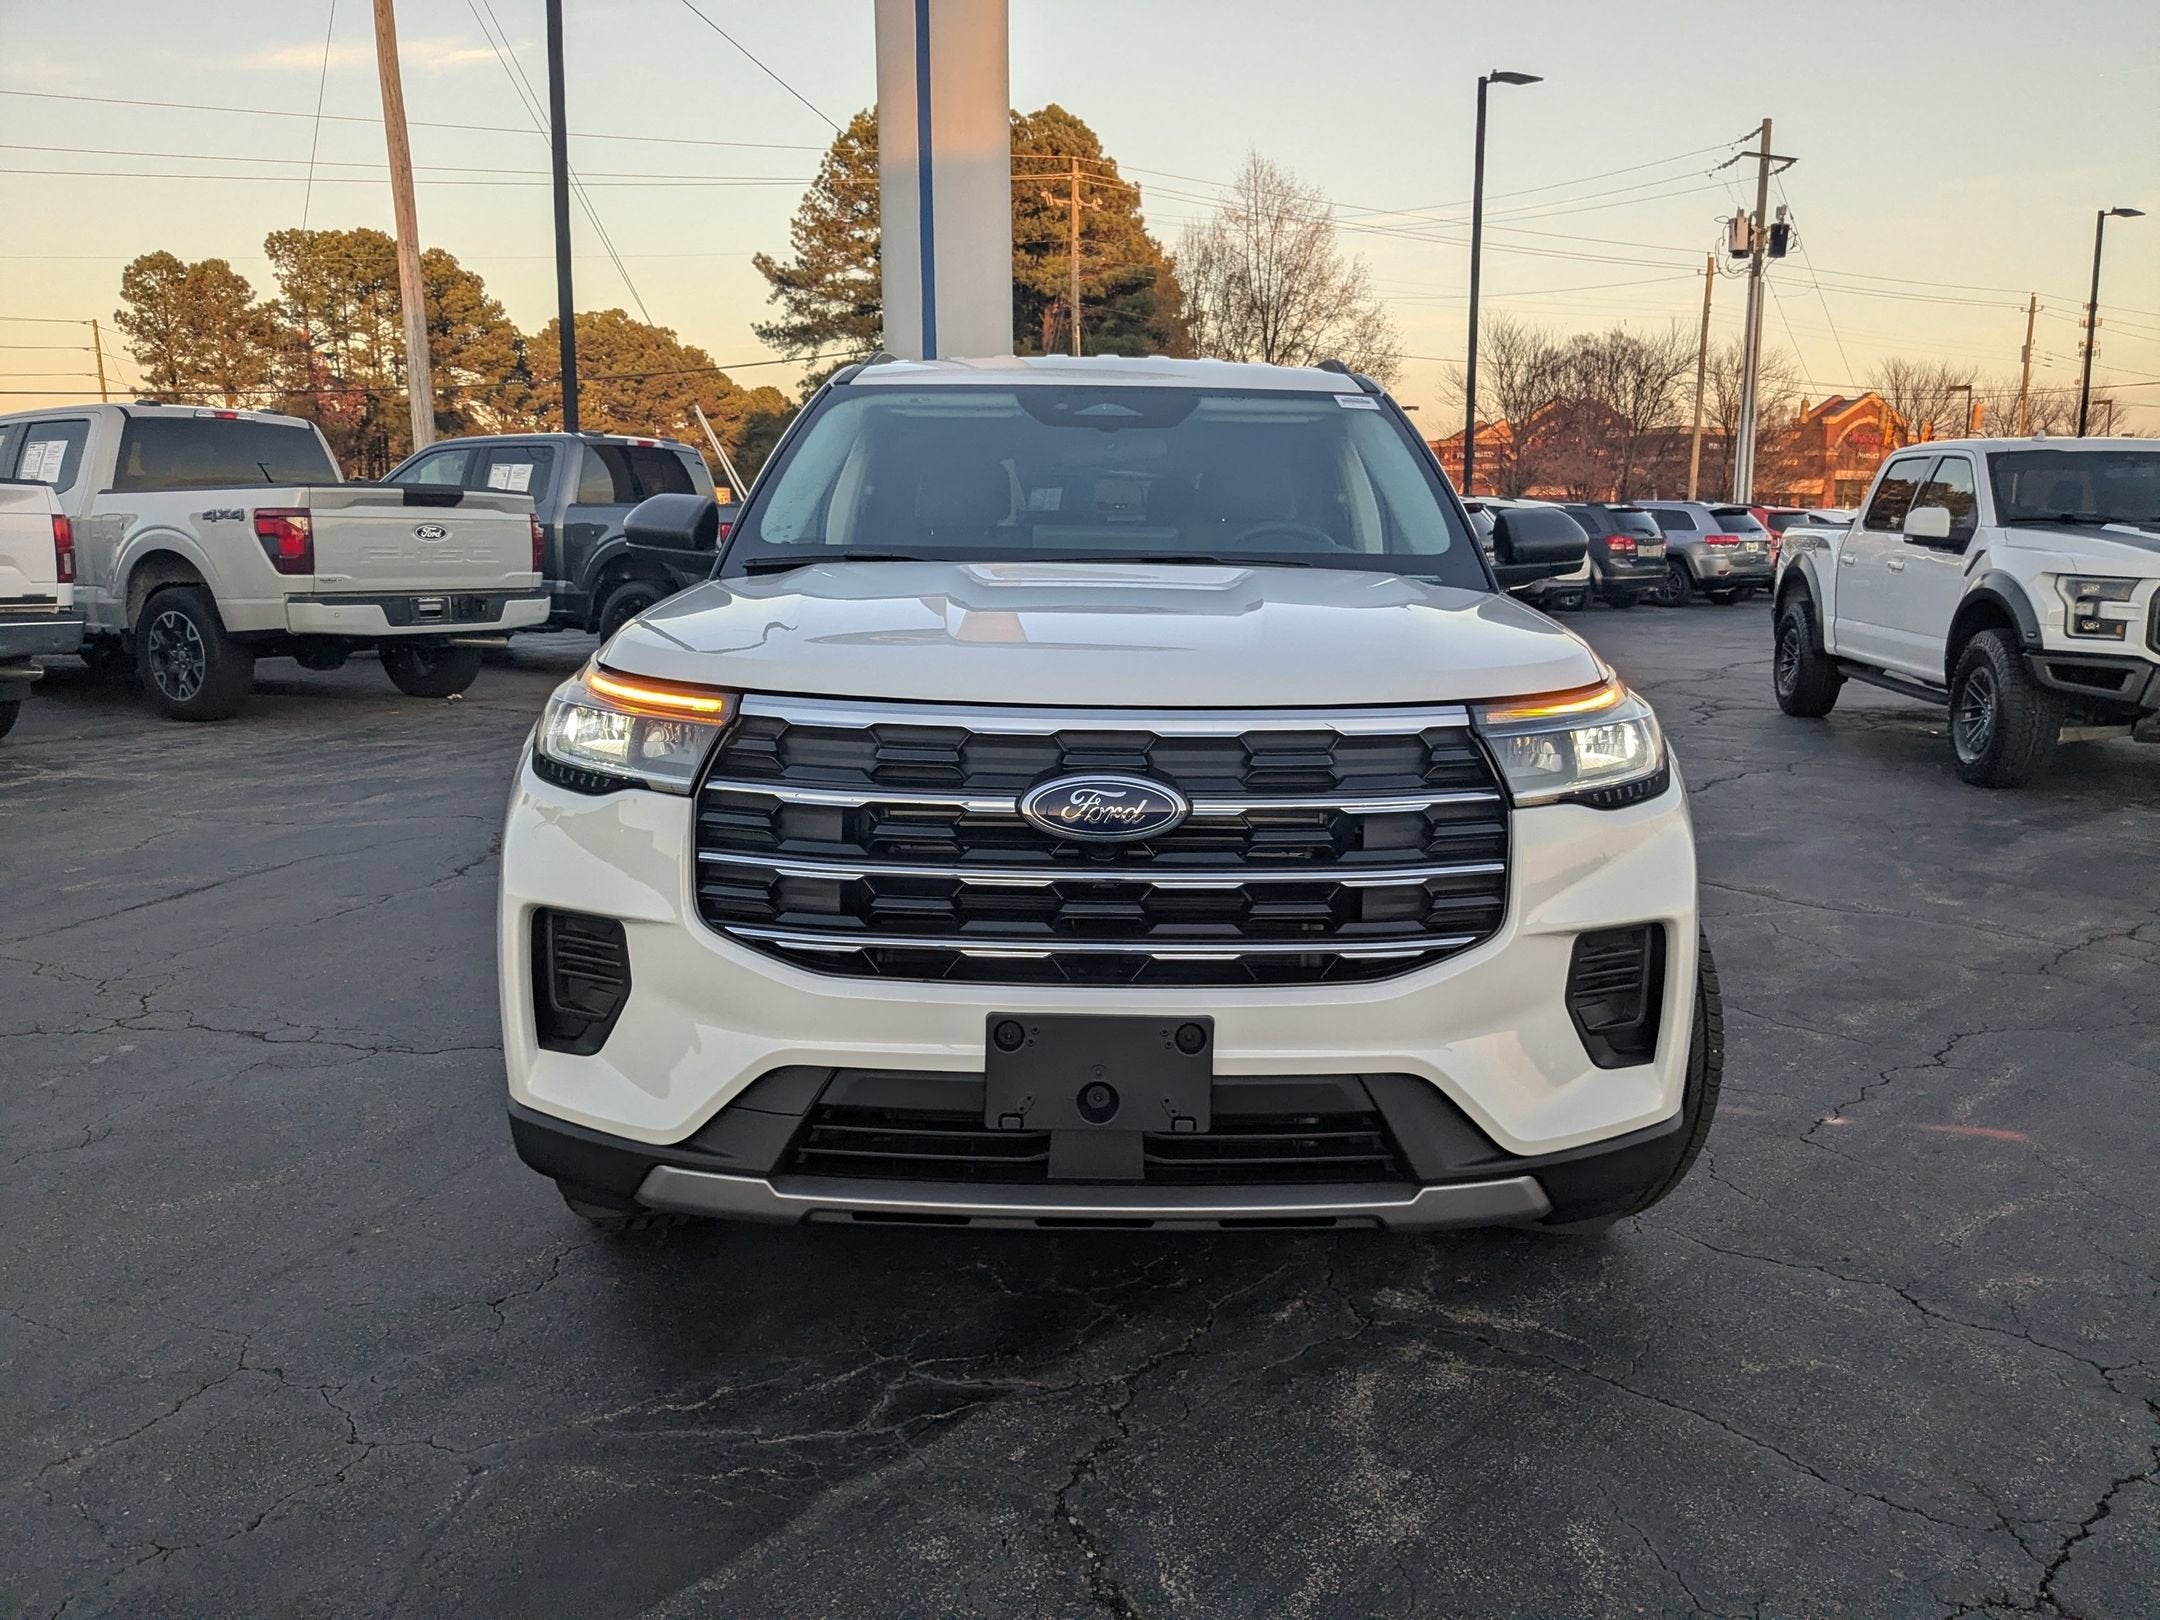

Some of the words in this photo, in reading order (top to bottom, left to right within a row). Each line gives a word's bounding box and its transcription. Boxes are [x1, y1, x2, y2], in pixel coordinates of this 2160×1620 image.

[421, 526, 442, 538] Ford
[359, 545, 500, 564] F-150
[1061, 788, 1148, 824] Ford
